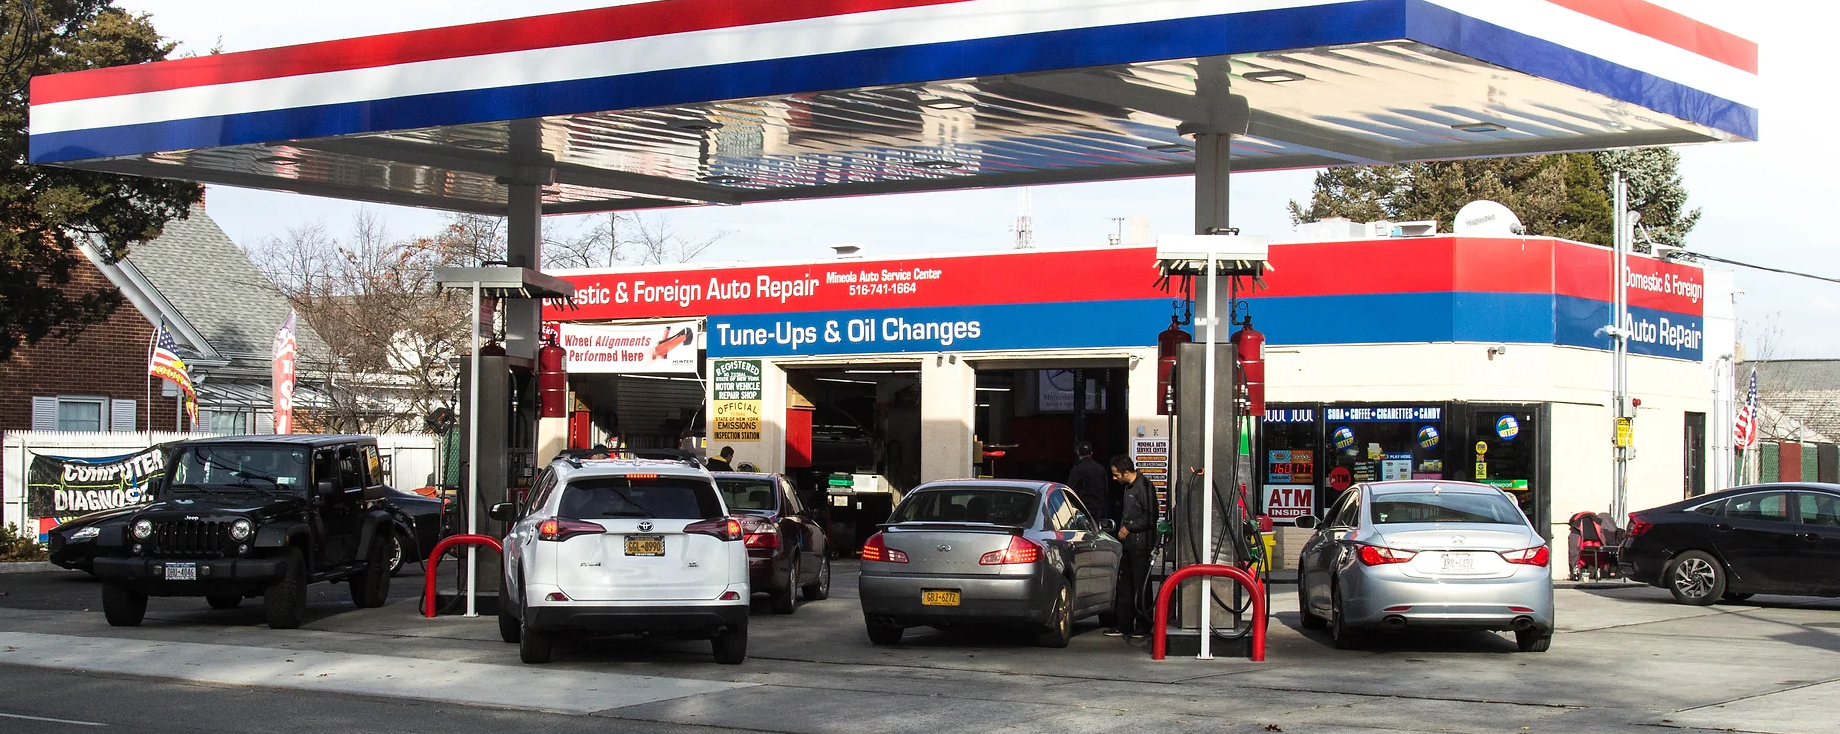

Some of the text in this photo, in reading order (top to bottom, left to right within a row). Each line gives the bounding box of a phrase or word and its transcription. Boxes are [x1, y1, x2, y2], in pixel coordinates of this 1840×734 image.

[826, 268, 942, 284] Mineola Auto Service Center
[615, 281, 629, 303] &
[634, 279, 701, 307] Foreign
[706, 277, 751, 300] Auto
[757, 273, 819, 303] Repair
[849, 282, 917, 296] 516-741-1664
[1626, 265, 1702, 304] Domestic & Foreign
[716, 317, 981, 350] Tune-Ups & Oil Changes
[1626, 312, 1701, 351] Auto Repair
[564, 335, 592, 347] Wheel
[595, 334, 651, 349] Alignments
[569, 350, 644, 362] Performed Here
[715, 360, 760, 376] REGISTERED
[715, 382, 760, 391] MOTOR VEHICLE
[719, 391, 758, 399] REPAIR SHOP
[717, 402, 758, 415] OFFICIAL
[1264, 409, 1314, 422] JUUL JUUL
[1328, 408, 1440, 419] SODA COFFEE CIGARETTES CANDY
[717, 422, 757, 430] EMISSIONS
[714, 432, 740, 440] INSPECTION
[63, 448, 164, 482] COMPUTER
[1274, 463, 1291, 474] 160
[1268, 488, 1312, 507] ATM
